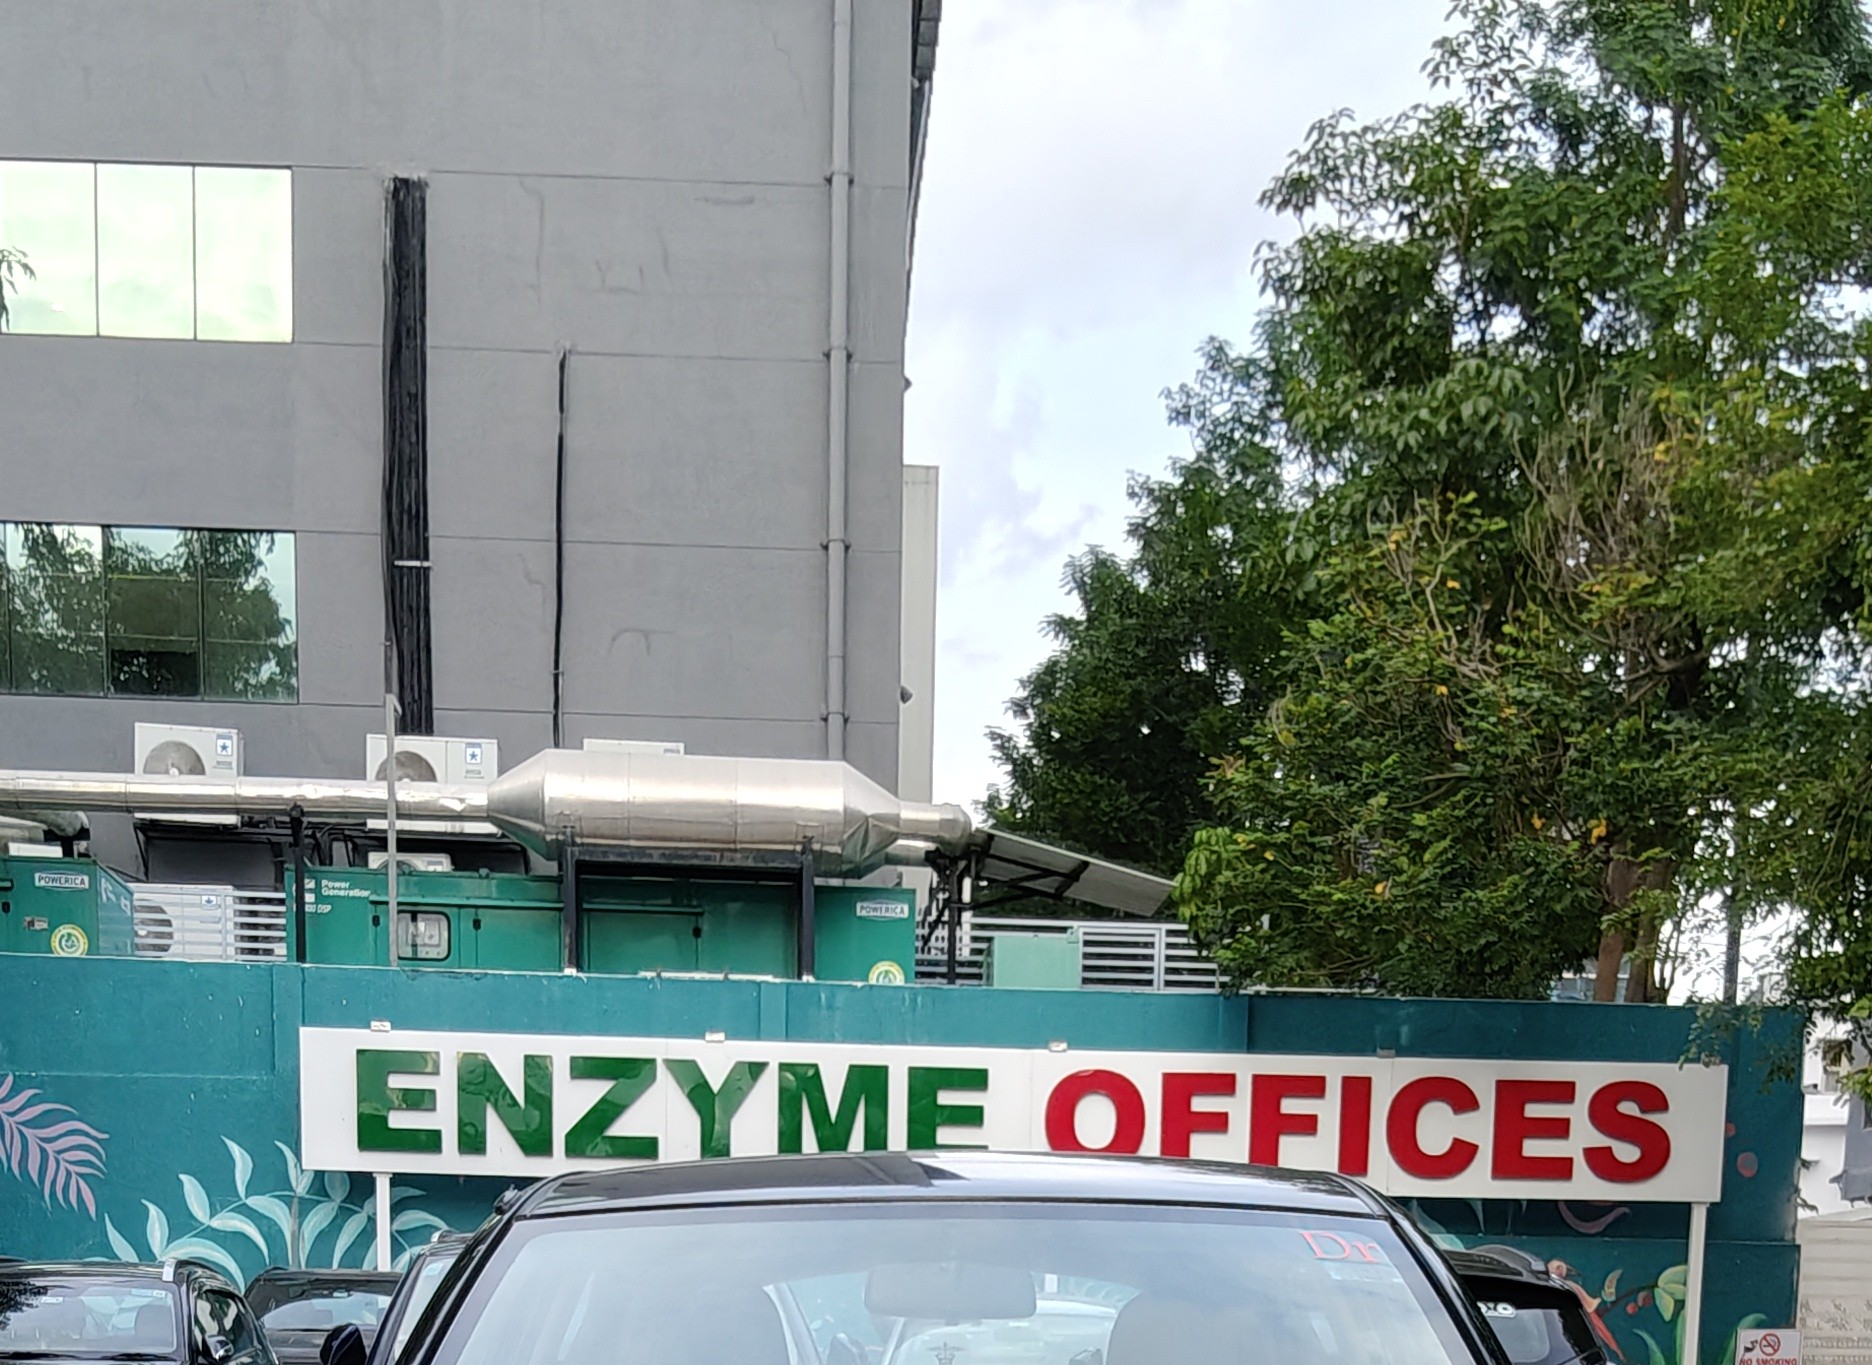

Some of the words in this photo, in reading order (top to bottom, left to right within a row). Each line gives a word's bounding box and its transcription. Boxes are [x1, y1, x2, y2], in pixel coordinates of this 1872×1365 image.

[38, 875, 86, 886] POWERICA
[321, 879, 350, 888] Power
[355, 1049, 989, 1159] ENZYME
[1044, 1068, 1671, 1182] OFFICES
[1300, 1231, 1378, 1264] Dr
